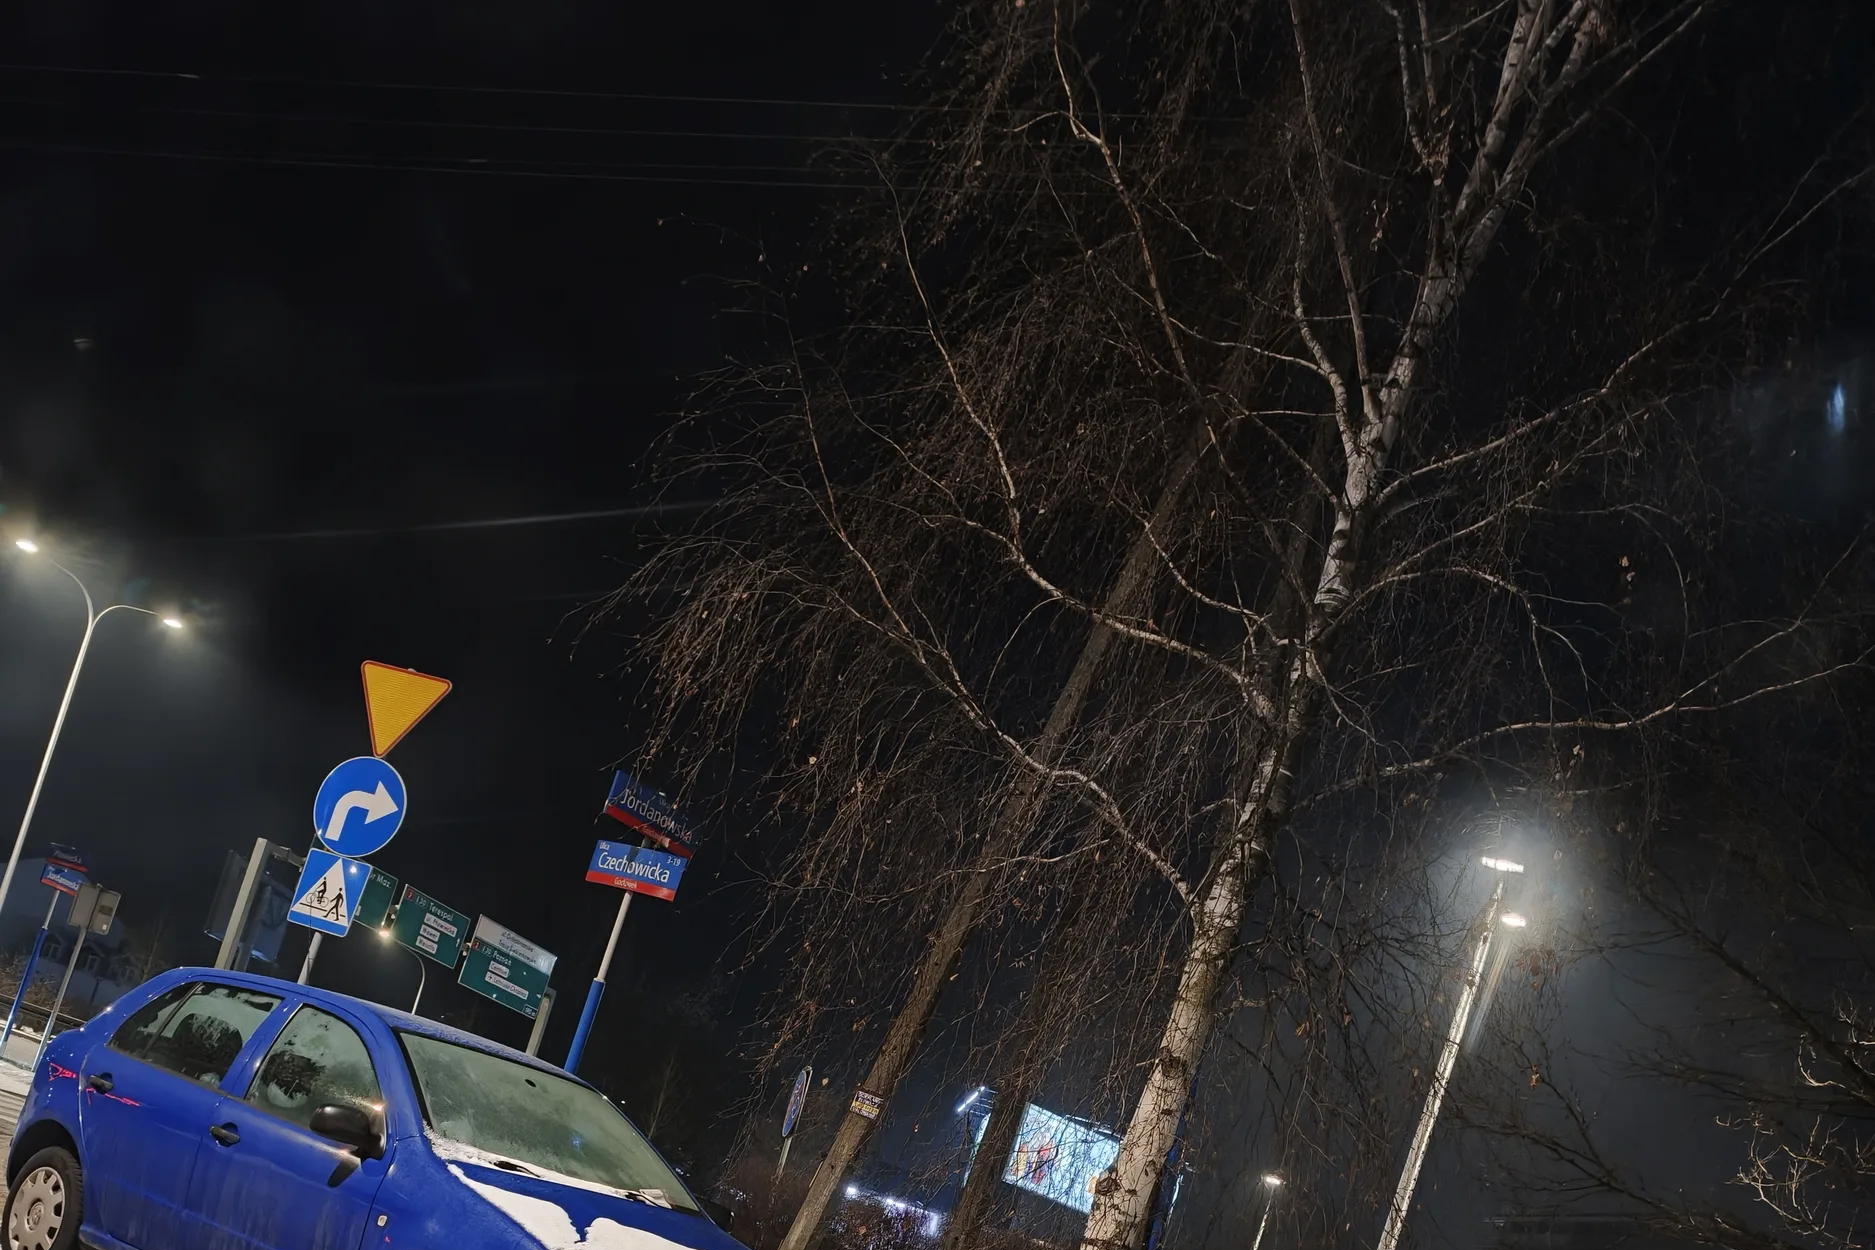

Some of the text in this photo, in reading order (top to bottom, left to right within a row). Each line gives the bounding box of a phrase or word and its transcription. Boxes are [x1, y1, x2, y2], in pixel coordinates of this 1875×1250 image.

[620, 789, 693, 843] Jordanowska
[598, 852, 670, 883] Czechowicka
[666, 855, 681, 867] 3-19
[429, 902, 454, 922] Terespol
